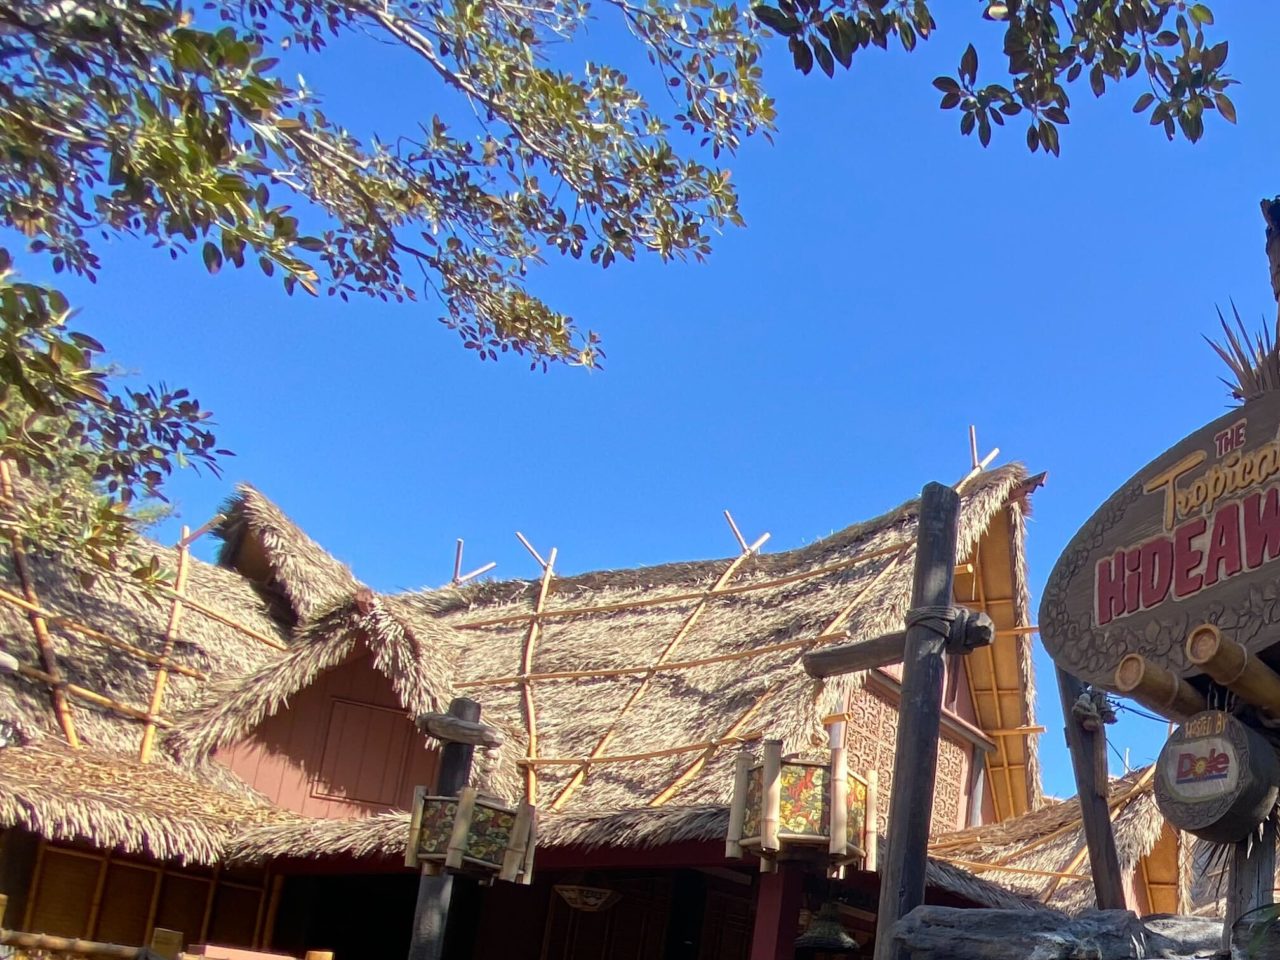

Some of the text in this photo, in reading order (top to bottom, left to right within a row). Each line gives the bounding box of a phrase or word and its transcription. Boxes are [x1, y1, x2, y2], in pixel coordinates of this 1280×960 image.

[1214, 418, 1247, 457] THE
[1184, 712, 1228, 738] HOSTED BY
[1176, 748, 1230, 780] Dole
